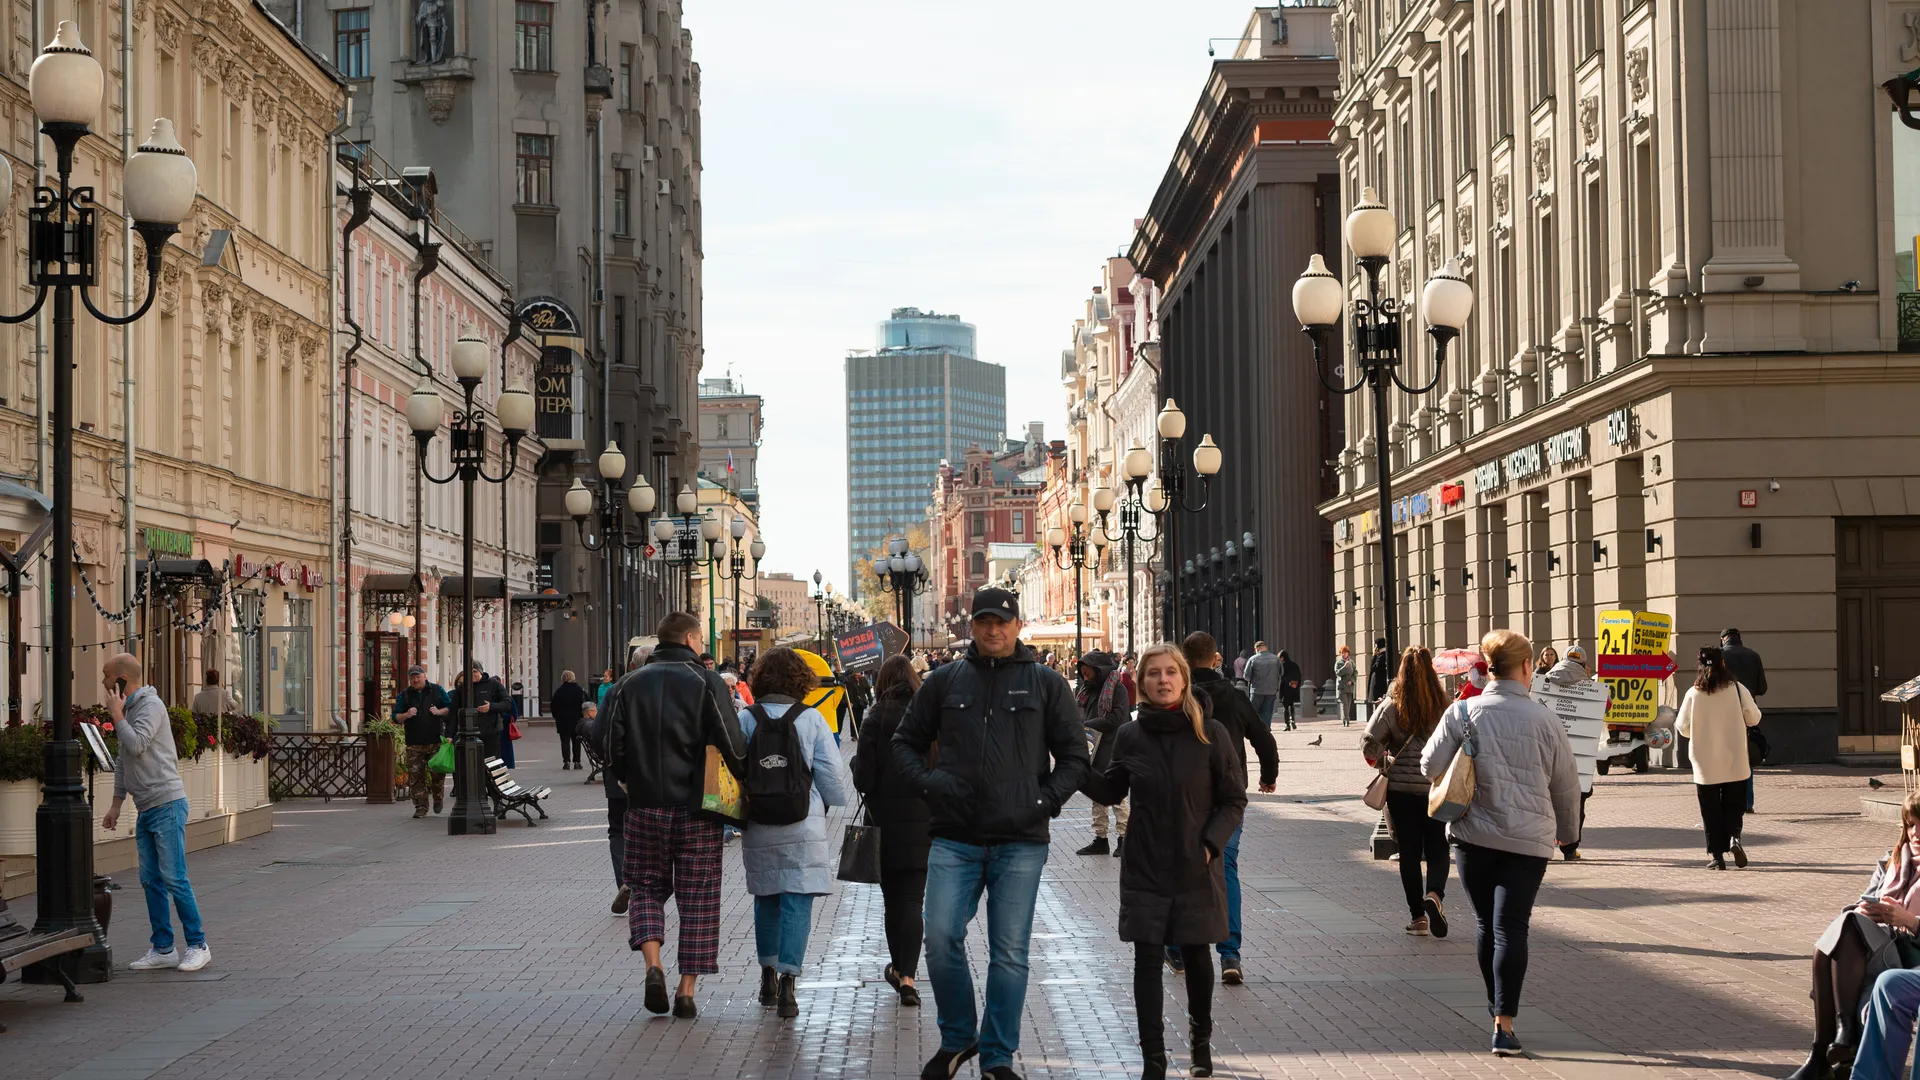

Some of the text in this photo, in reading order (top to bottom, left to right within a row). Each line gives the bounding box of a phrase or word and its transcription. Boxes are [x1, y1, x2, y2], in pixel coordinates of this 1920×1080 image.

[539, 377, 566, 393] ОМ
[1607, 408, 1628, 446] БУСЫ
[840, 630, 874, 648] МУЗЕЙ
[1602, 628, 1628, 655] 2+1
[1635, 629, 1668, 645] 5 БОЛЬШИХ
[1604, 679, 1652, 701] 50%
